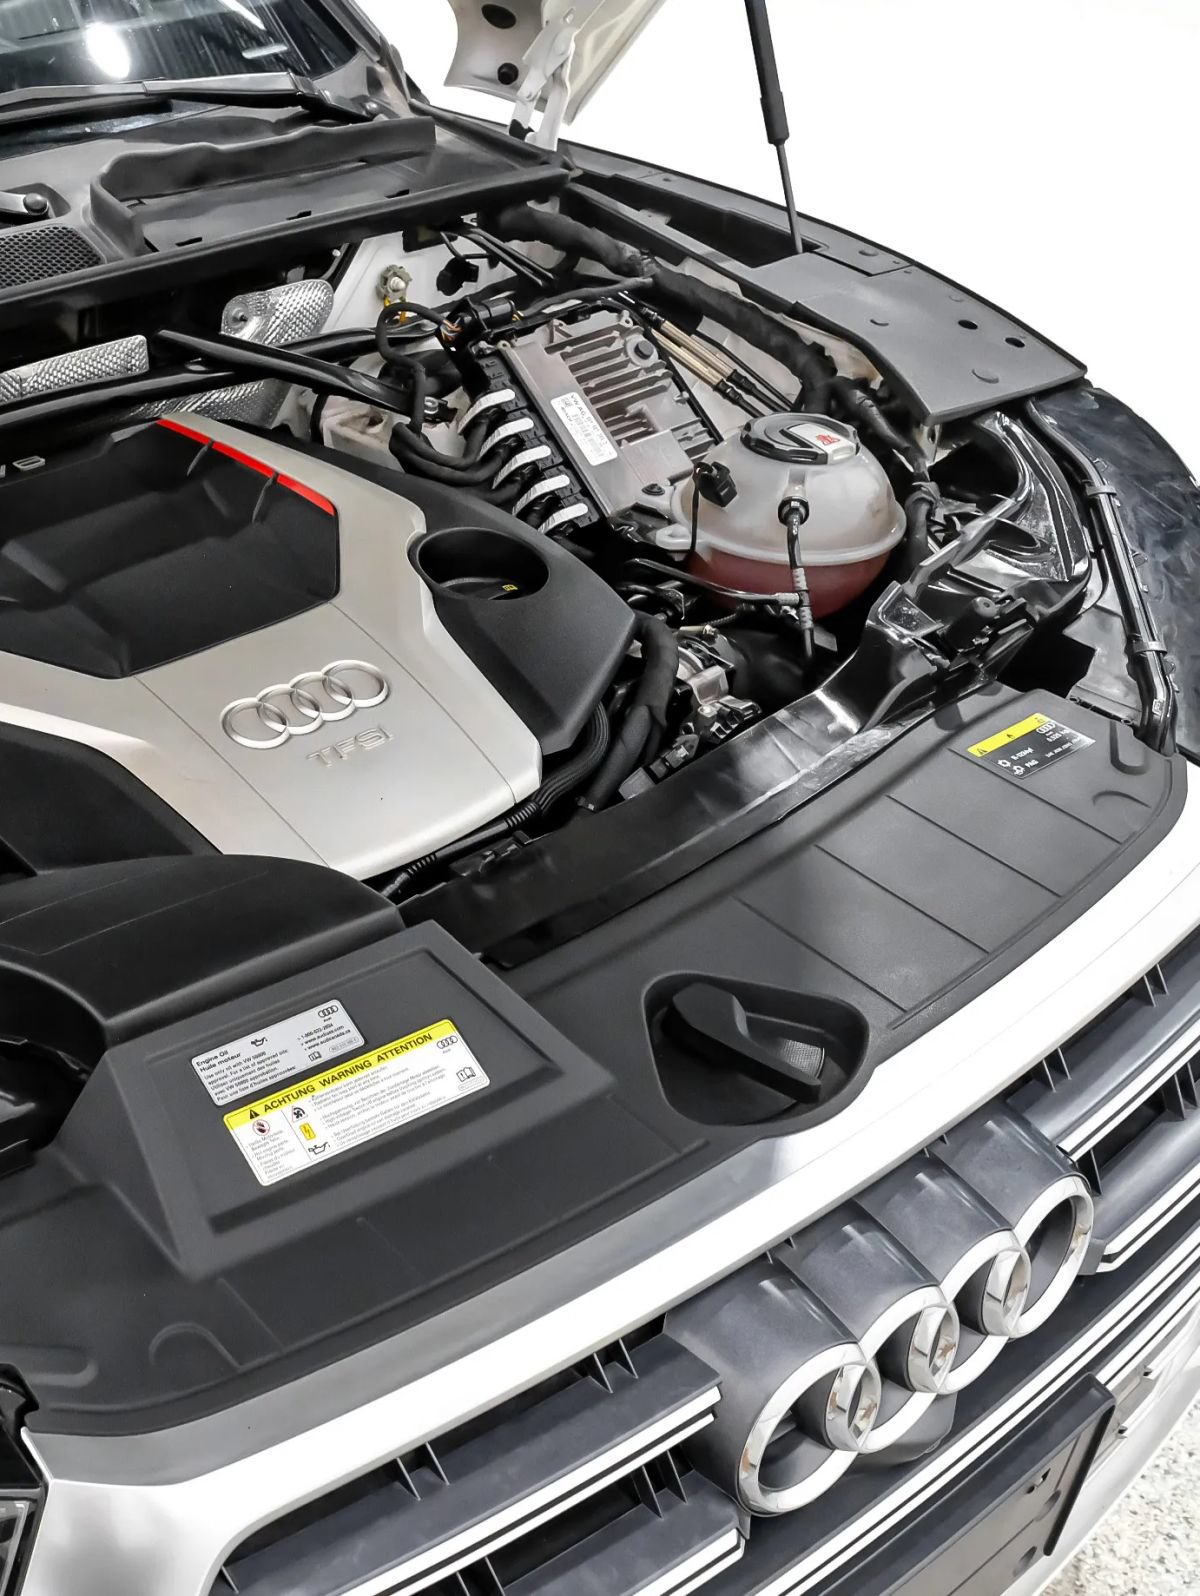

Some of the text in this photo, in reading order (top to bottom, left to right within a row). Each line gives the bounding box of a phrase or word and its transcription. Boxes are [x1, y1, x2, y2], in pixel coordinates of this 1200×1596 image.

[306, 725, 394, 767] TFSI
[195, 1054, 219, 1067] Engine
[198, 1053, 241, 1072] Huile moteur
[255, 1053, 279, 1065] approved
[210, 1081, 228, 1091] Utiliser
[228, 1069, 257, 1084] uniquement
[264, 1059, 280, 1067] huiles
[248, 1067, 278, 1081] approbation.
[264, 1084, 316, 1112] ACHTUNG
[319, 1060, 372, 1087] WARNING
[377, 1033, 433, 1063] ATTENTION
[248, 1077, 268, 1088] d'huiles
